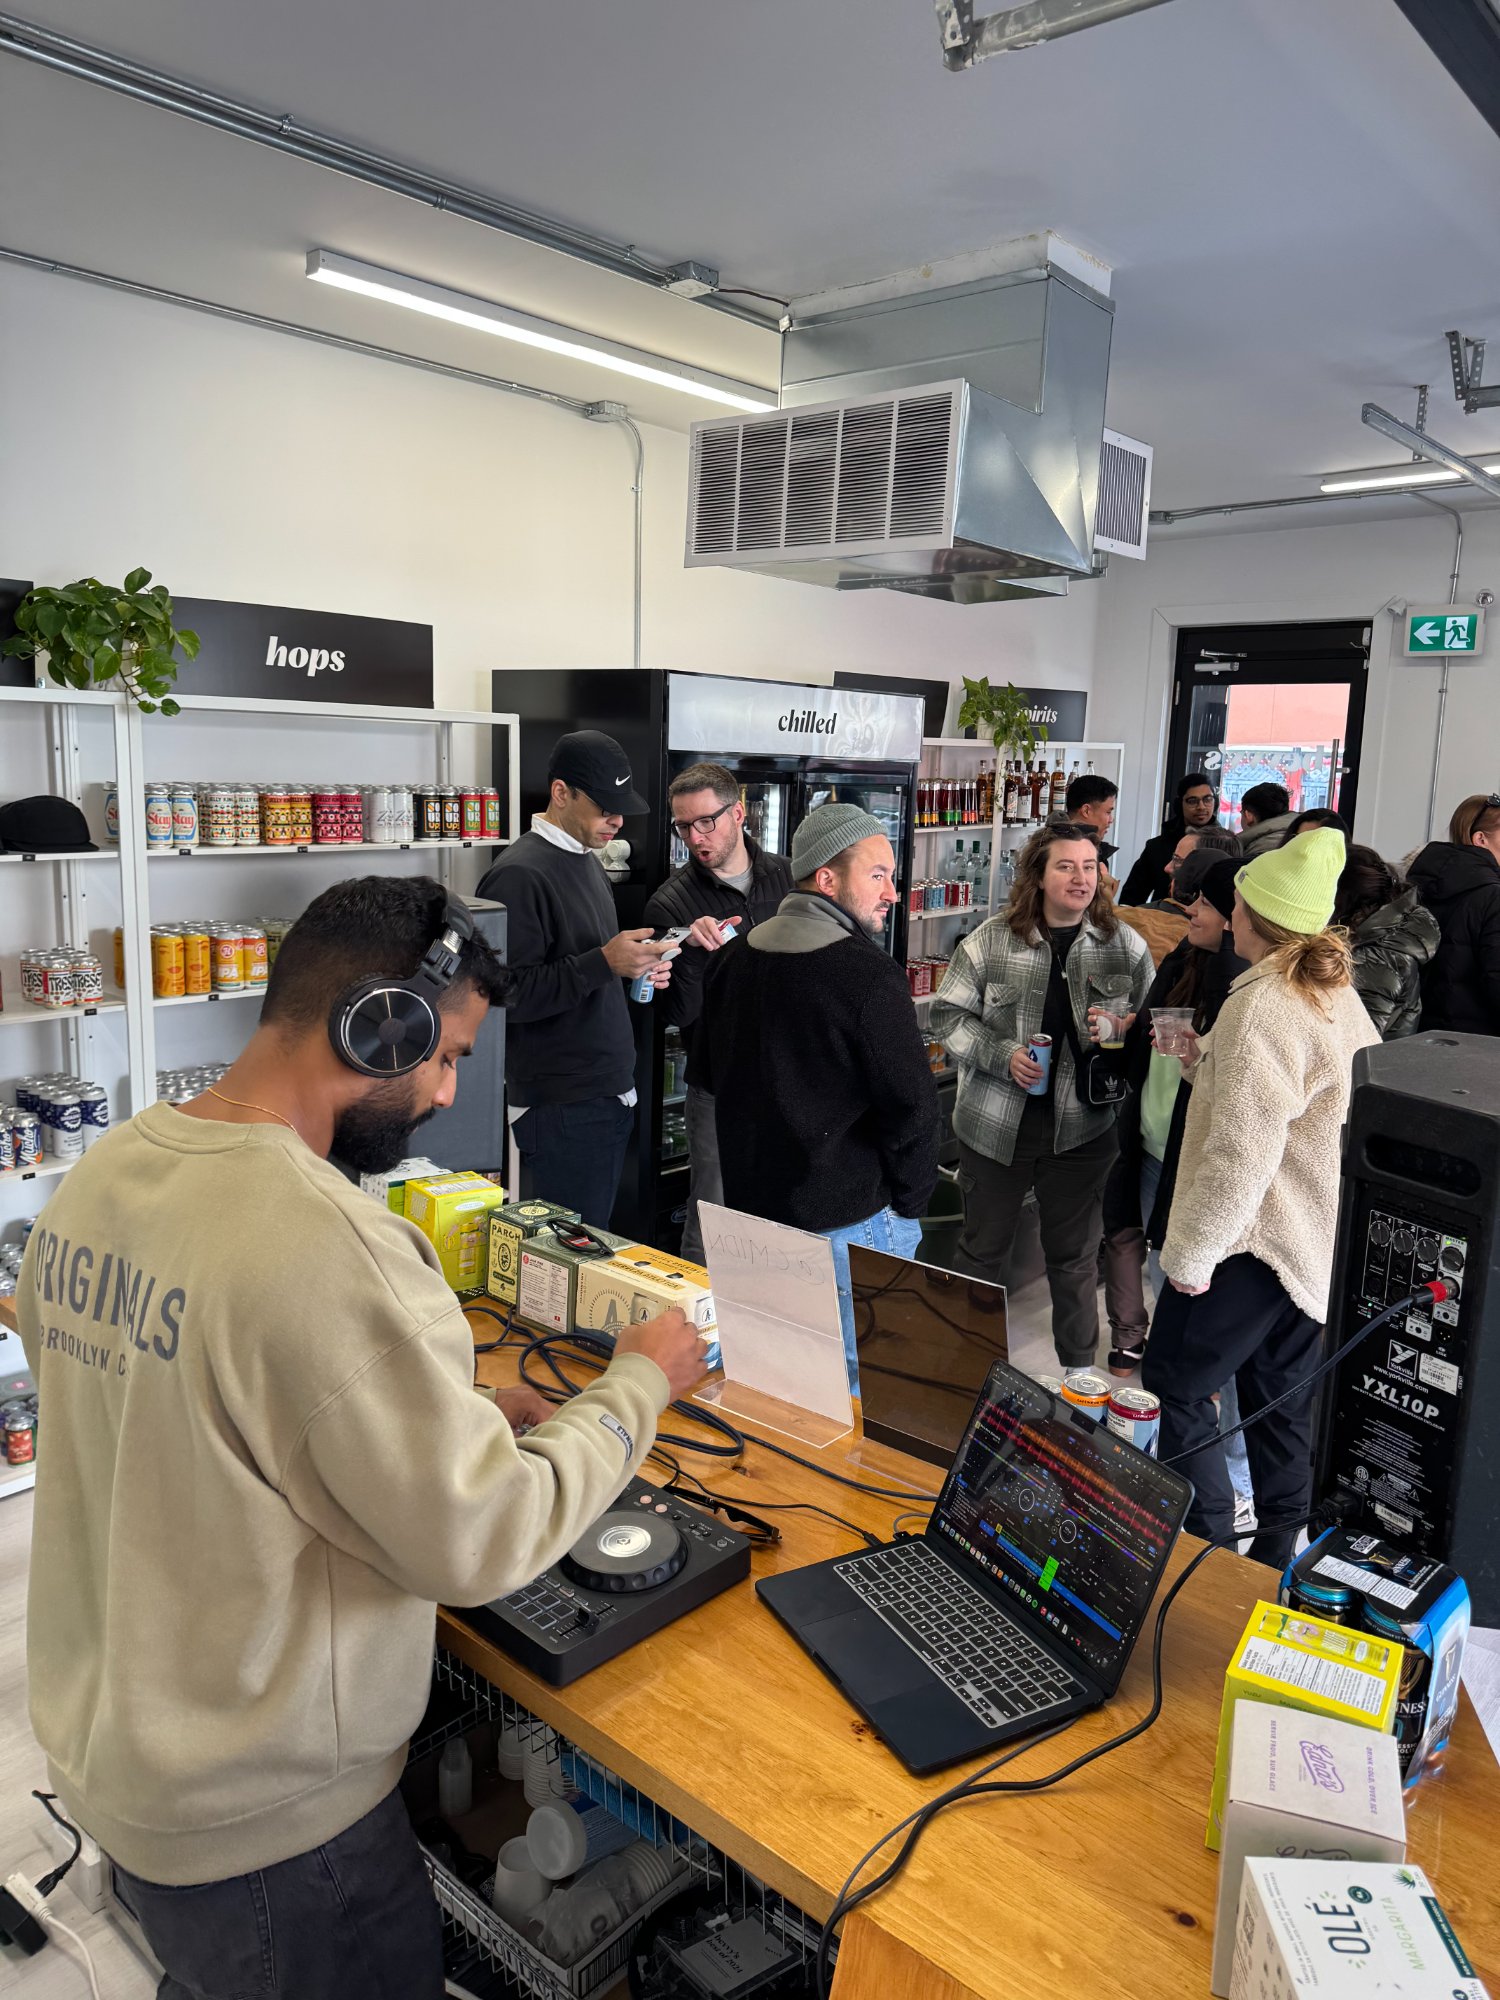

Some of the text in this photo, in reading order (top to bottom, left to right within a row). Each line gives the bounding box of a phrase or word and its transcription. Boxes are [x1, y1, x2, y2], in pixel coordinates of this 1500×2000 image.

[266, 635, 346, 677] hops
[778, 709, 837, 734] chilled
[1015, 705, 1058, 723] pirits
[108, 808, 119, 821] St
[148, 813, 171, 829] Stay
[36, 1229, 186, 1361] ORIGINALS
[1373, 1365, 1429, 1394] www.yorkville.com
[1390, 1362, 1414, 1377] Yorkville
[1363, 1374, 1439, 1418] YXL10P
[1304, 1902, 1371, 1955] OLÉ
[1380, 1896, 1426, 1971] MARGARITA
[706, 1939, 720, 1954] best
[726, 1956, 744, 1974] 2024
